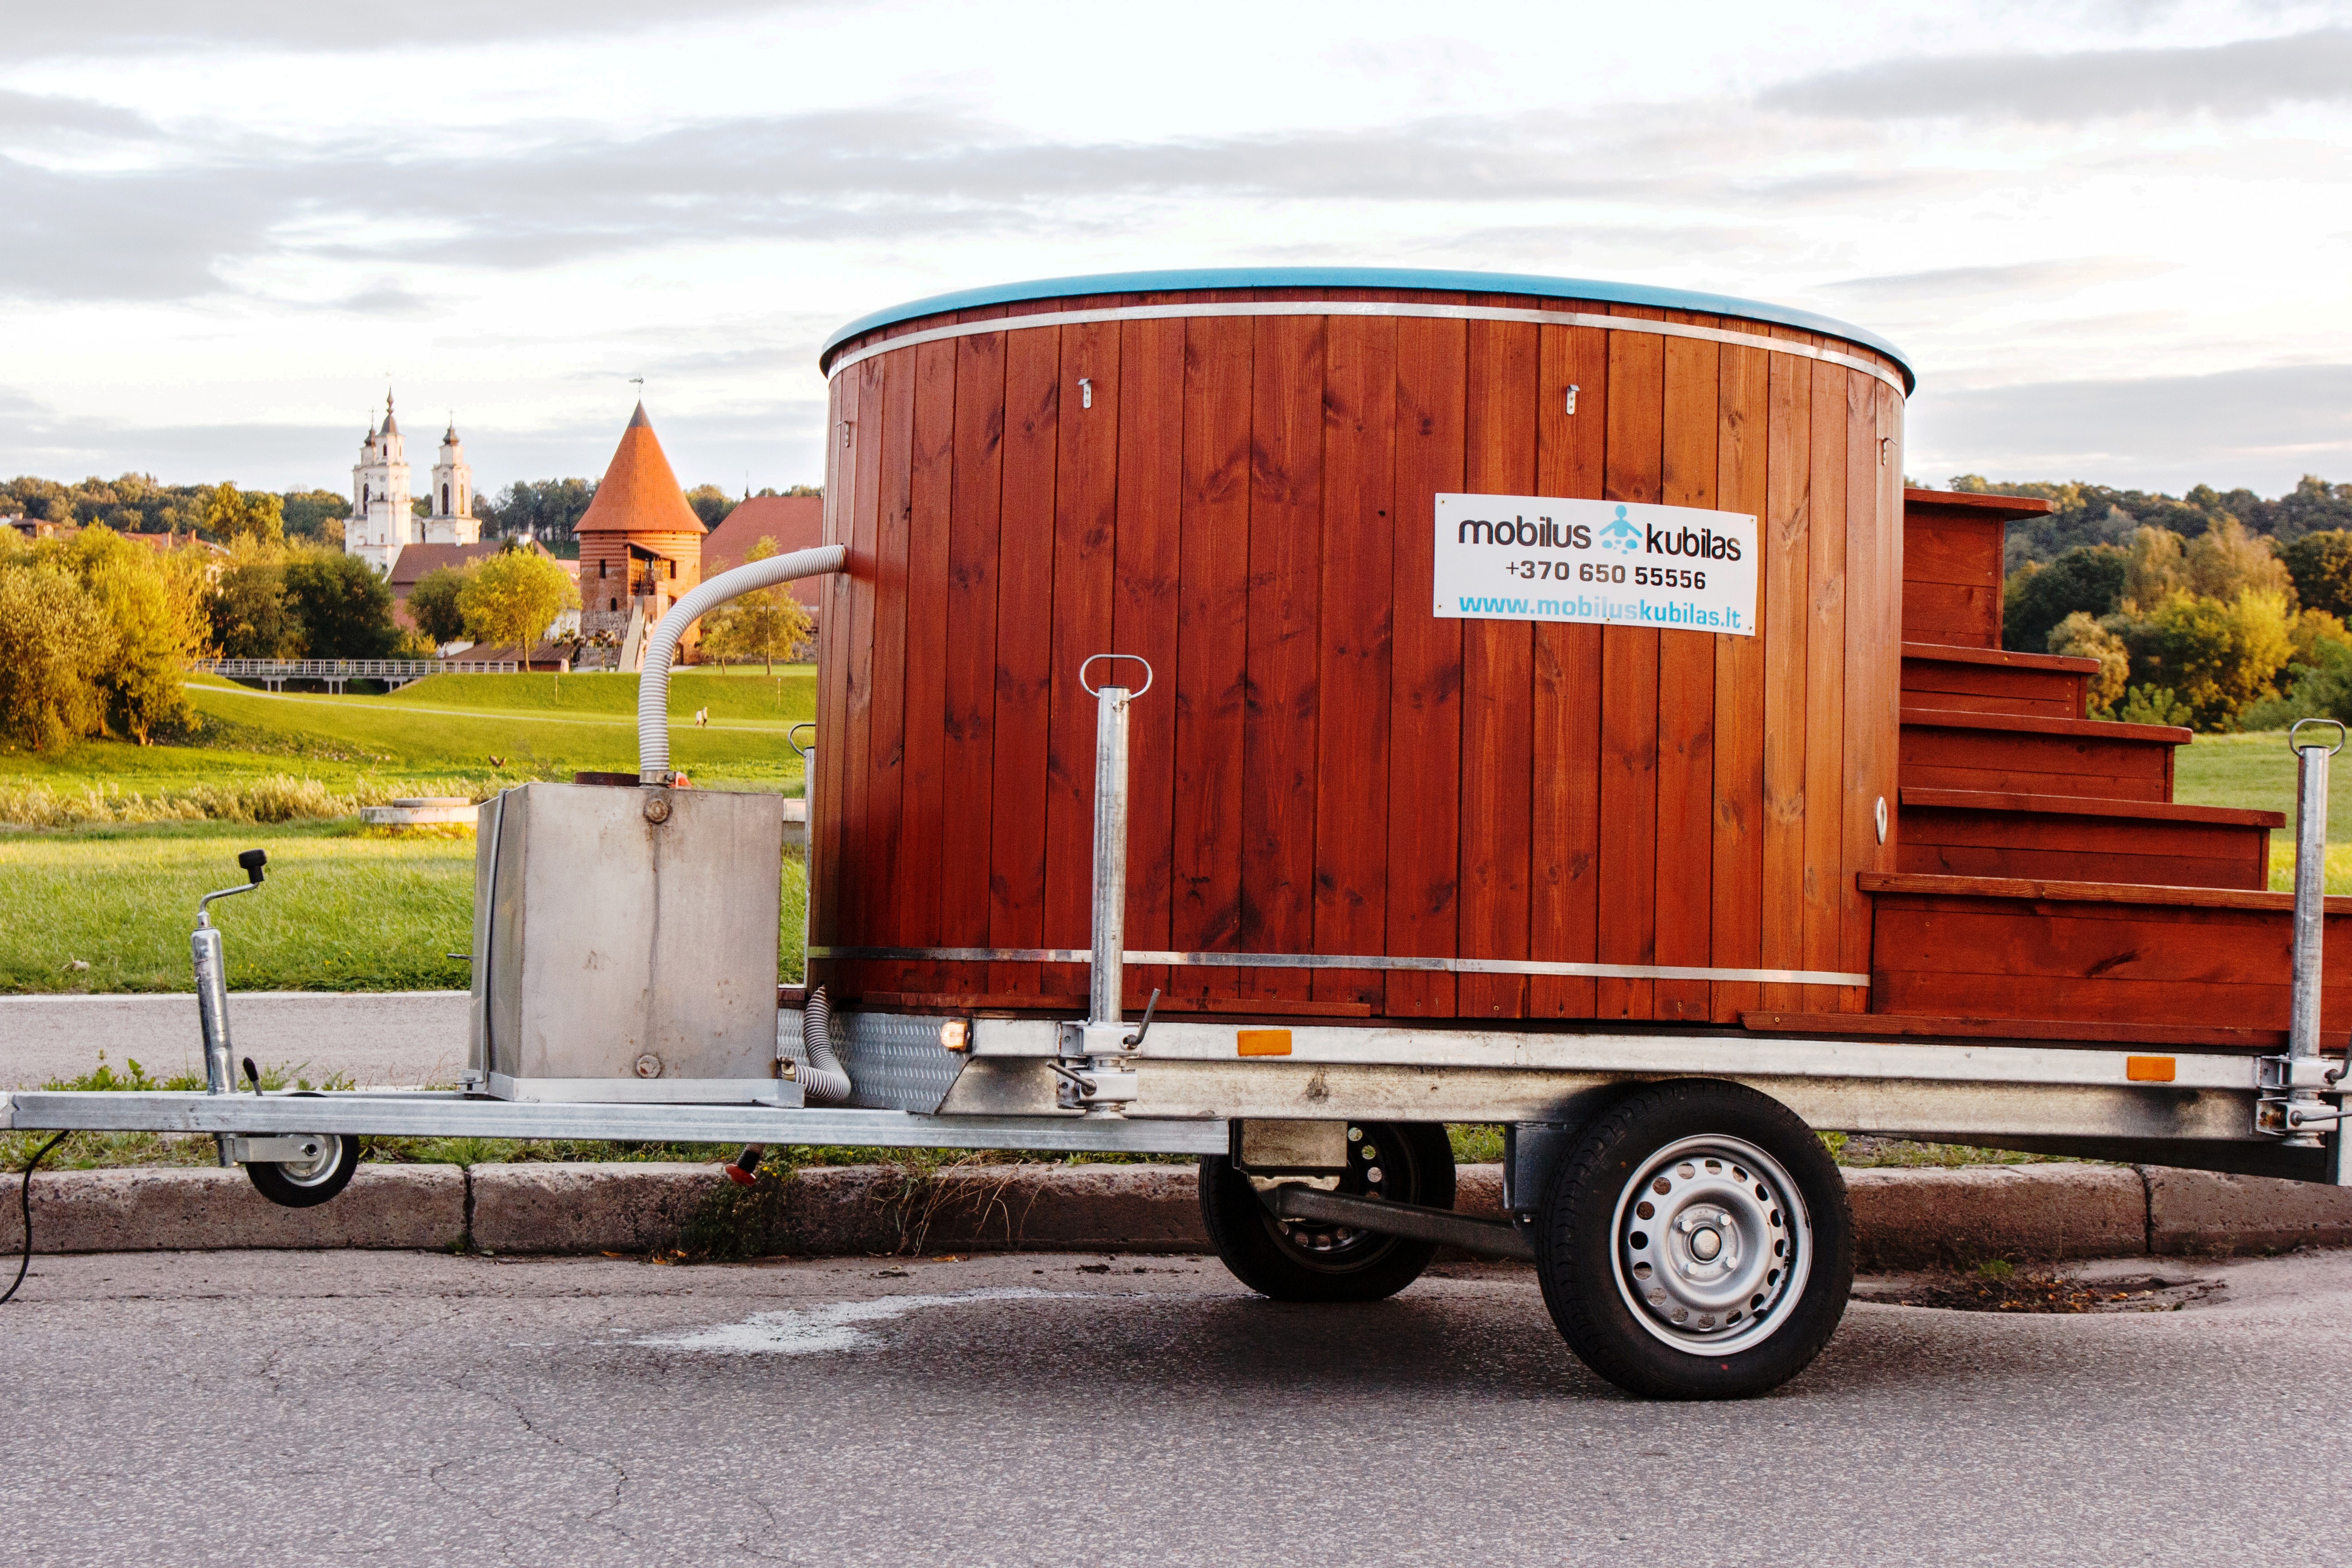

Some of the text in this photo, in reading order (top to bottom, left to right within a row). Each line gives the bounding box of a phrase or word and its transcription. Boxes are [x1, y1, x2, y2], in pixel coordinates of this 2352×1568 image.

[1458, 515, 1741, 561] mobilus kubilas
[1505, 560, 1706, 590] +370 650 55556
[1459, 595, 1741, 629] www.mobiluskubilas.lt
